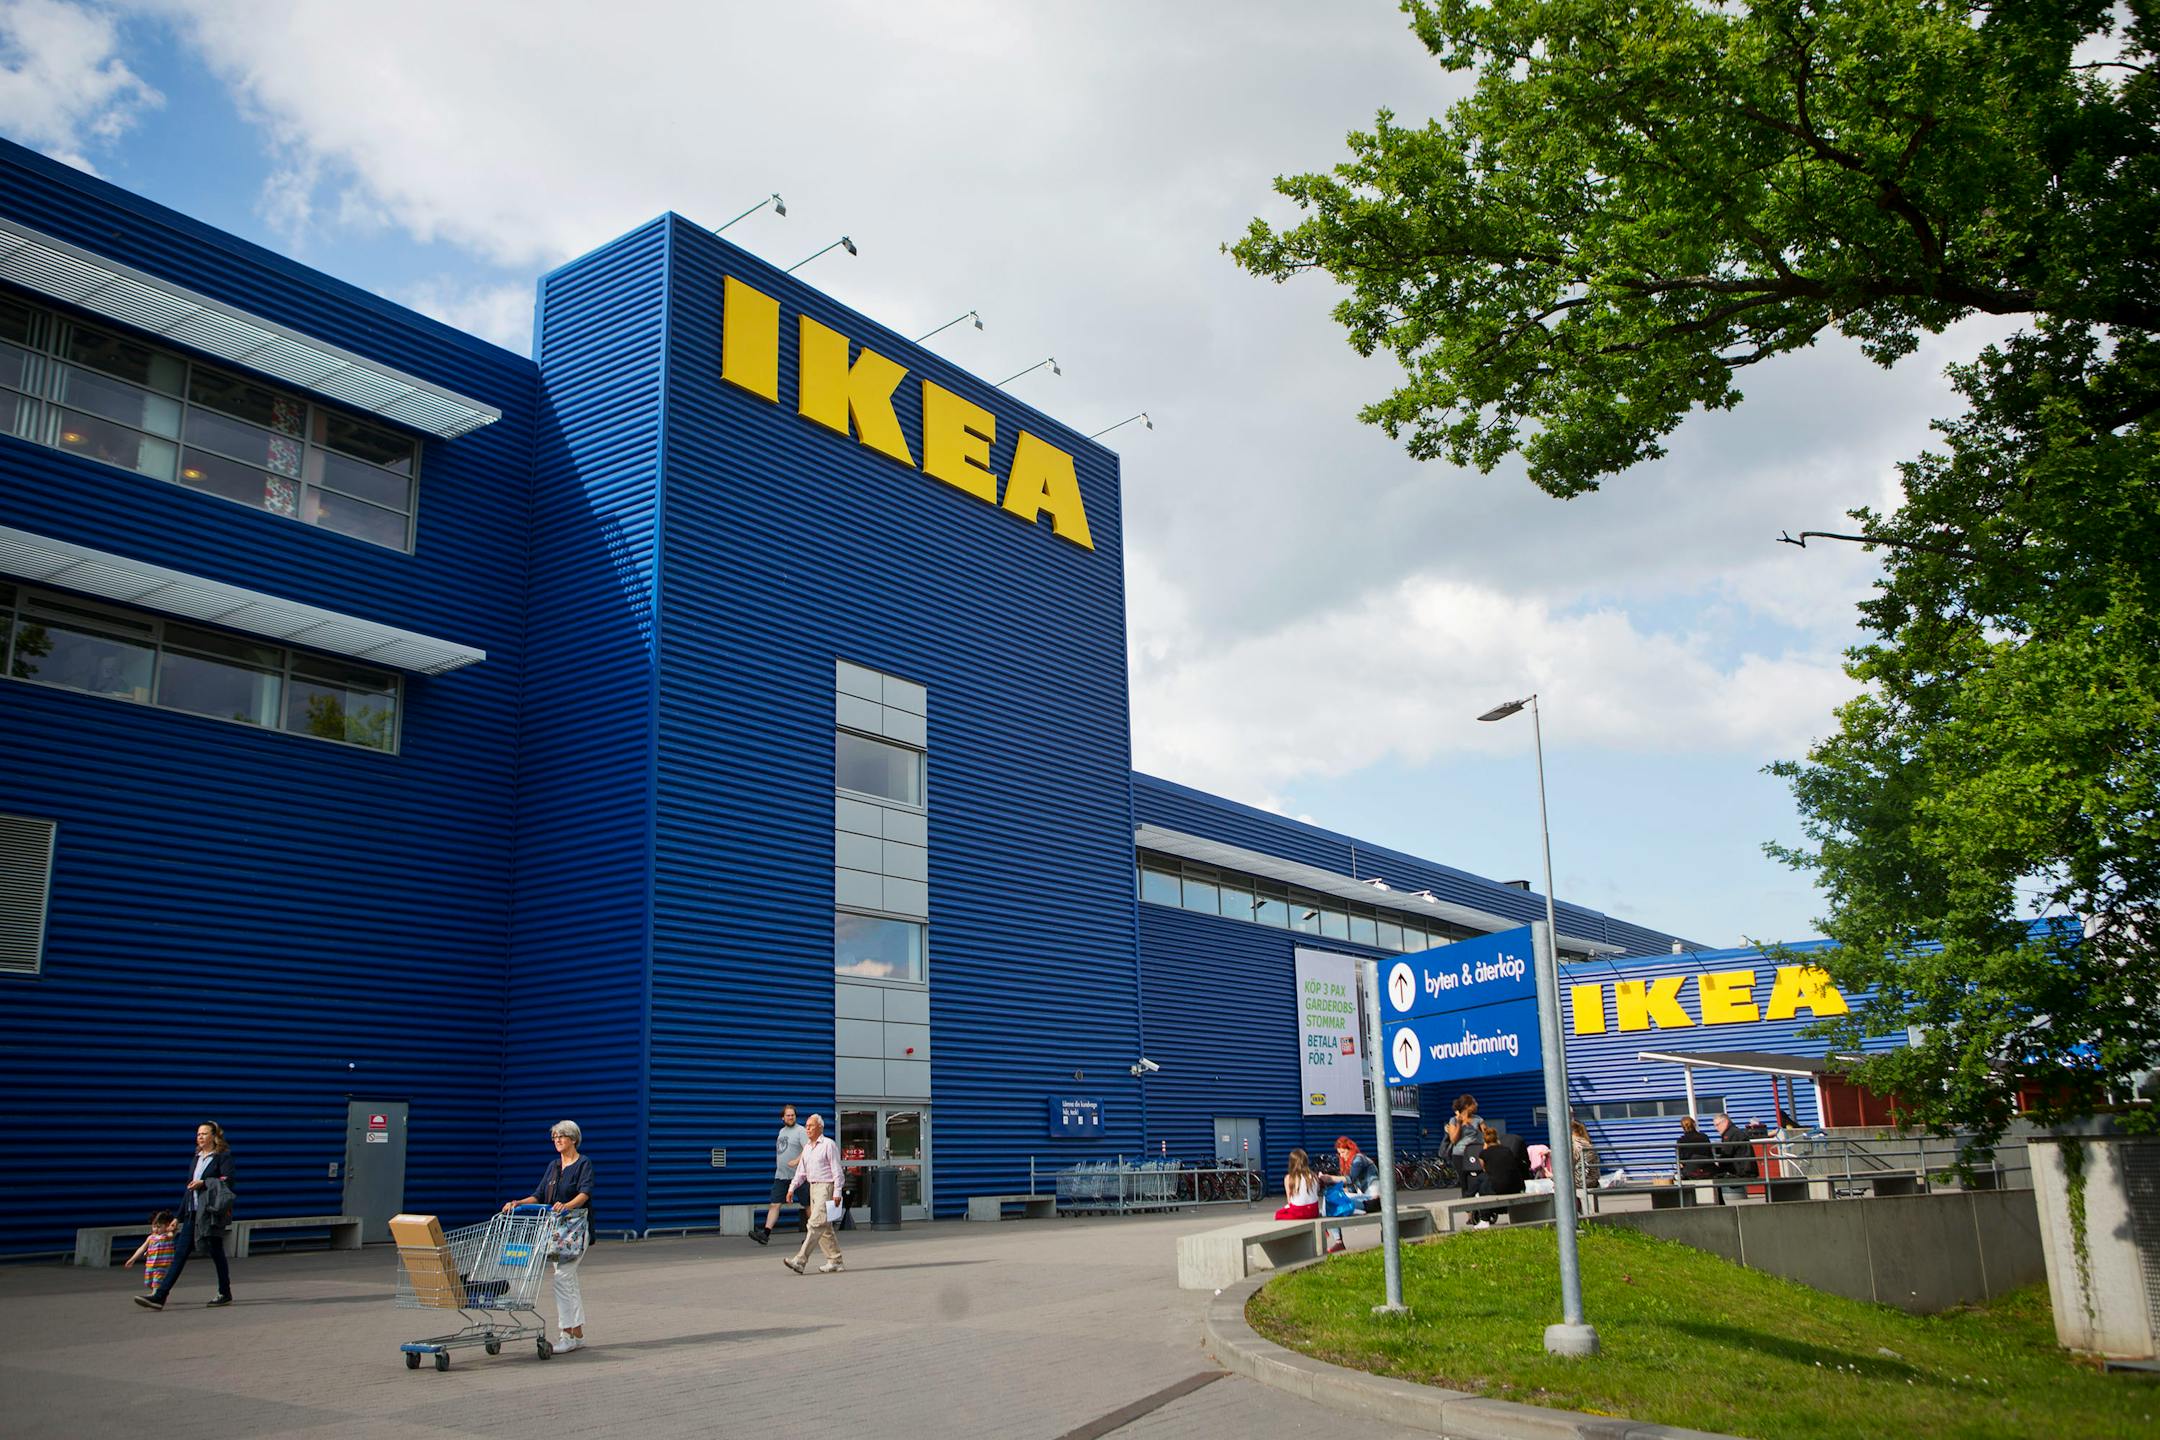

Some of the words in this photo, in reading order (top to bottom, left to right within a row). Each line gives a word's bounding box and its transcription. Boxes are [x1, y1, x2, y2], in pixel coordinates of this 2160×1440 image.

[720, 274, 1096, 552] IKEA
[1424, 969, 1459, 998] byten
[1461, 963, 1473, 986] &
[1475, 952, 1525, 982] återköp
[1304, 977, 1321, 994] KÖP
[1323, 983, 1329, 995] 3
[1330, 983, 1346, 997] PAX
[1305, 997, 1356, 1014] GARDEROBS-
[1570, 964, 1849, 1035] IKEA
[1306, 1014, 1346, 1029] STOMMAR
[1307, 1034, 1338, 1048] BETALA
[1429, 1028, 1519, 1060] varuutlämning
[1308, 1049, 1325, 1065] FÖR
[1327, 1053, 1333, 1065] 2
